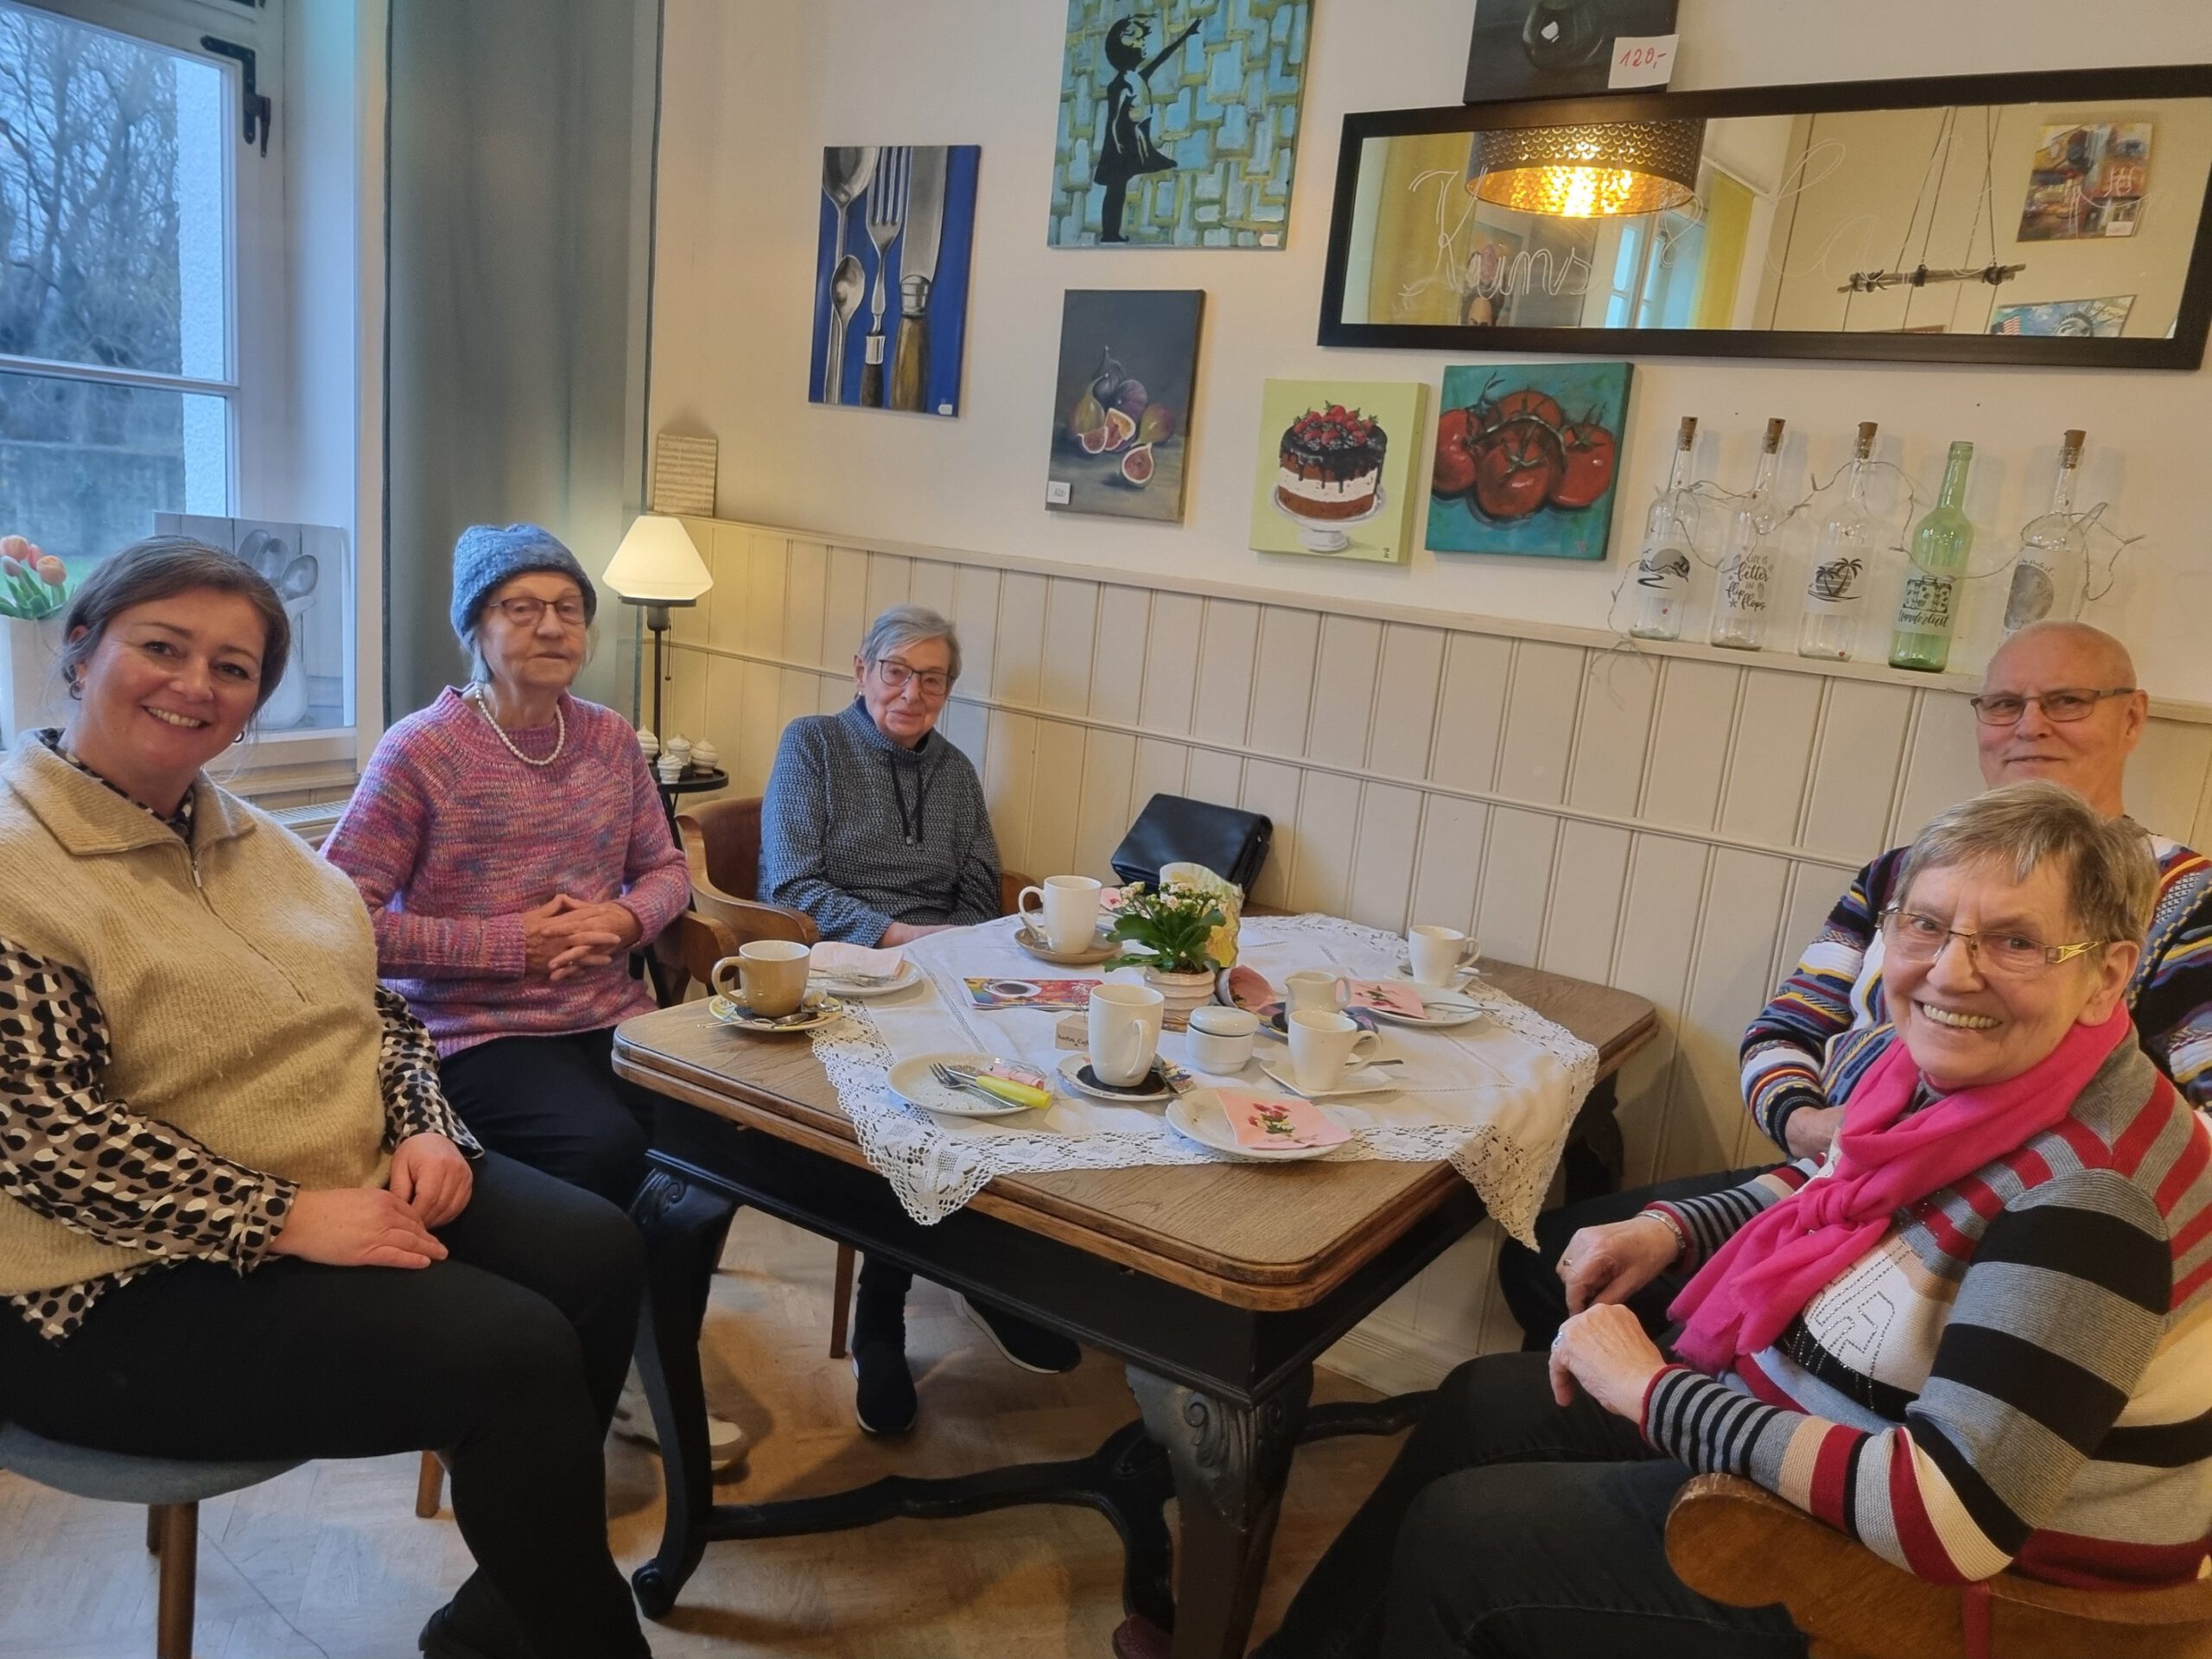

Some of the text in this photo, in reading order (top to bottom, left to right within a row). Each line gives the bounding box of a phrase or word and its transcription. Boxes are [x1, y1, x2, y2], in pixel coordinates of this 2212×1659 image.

[1619, 48, 1668, 69] 120,-
[1733, 561, 1770, 582] better
[1725, 581, 1745, 601] flip
[1741, 593, 1766, 612] flops
